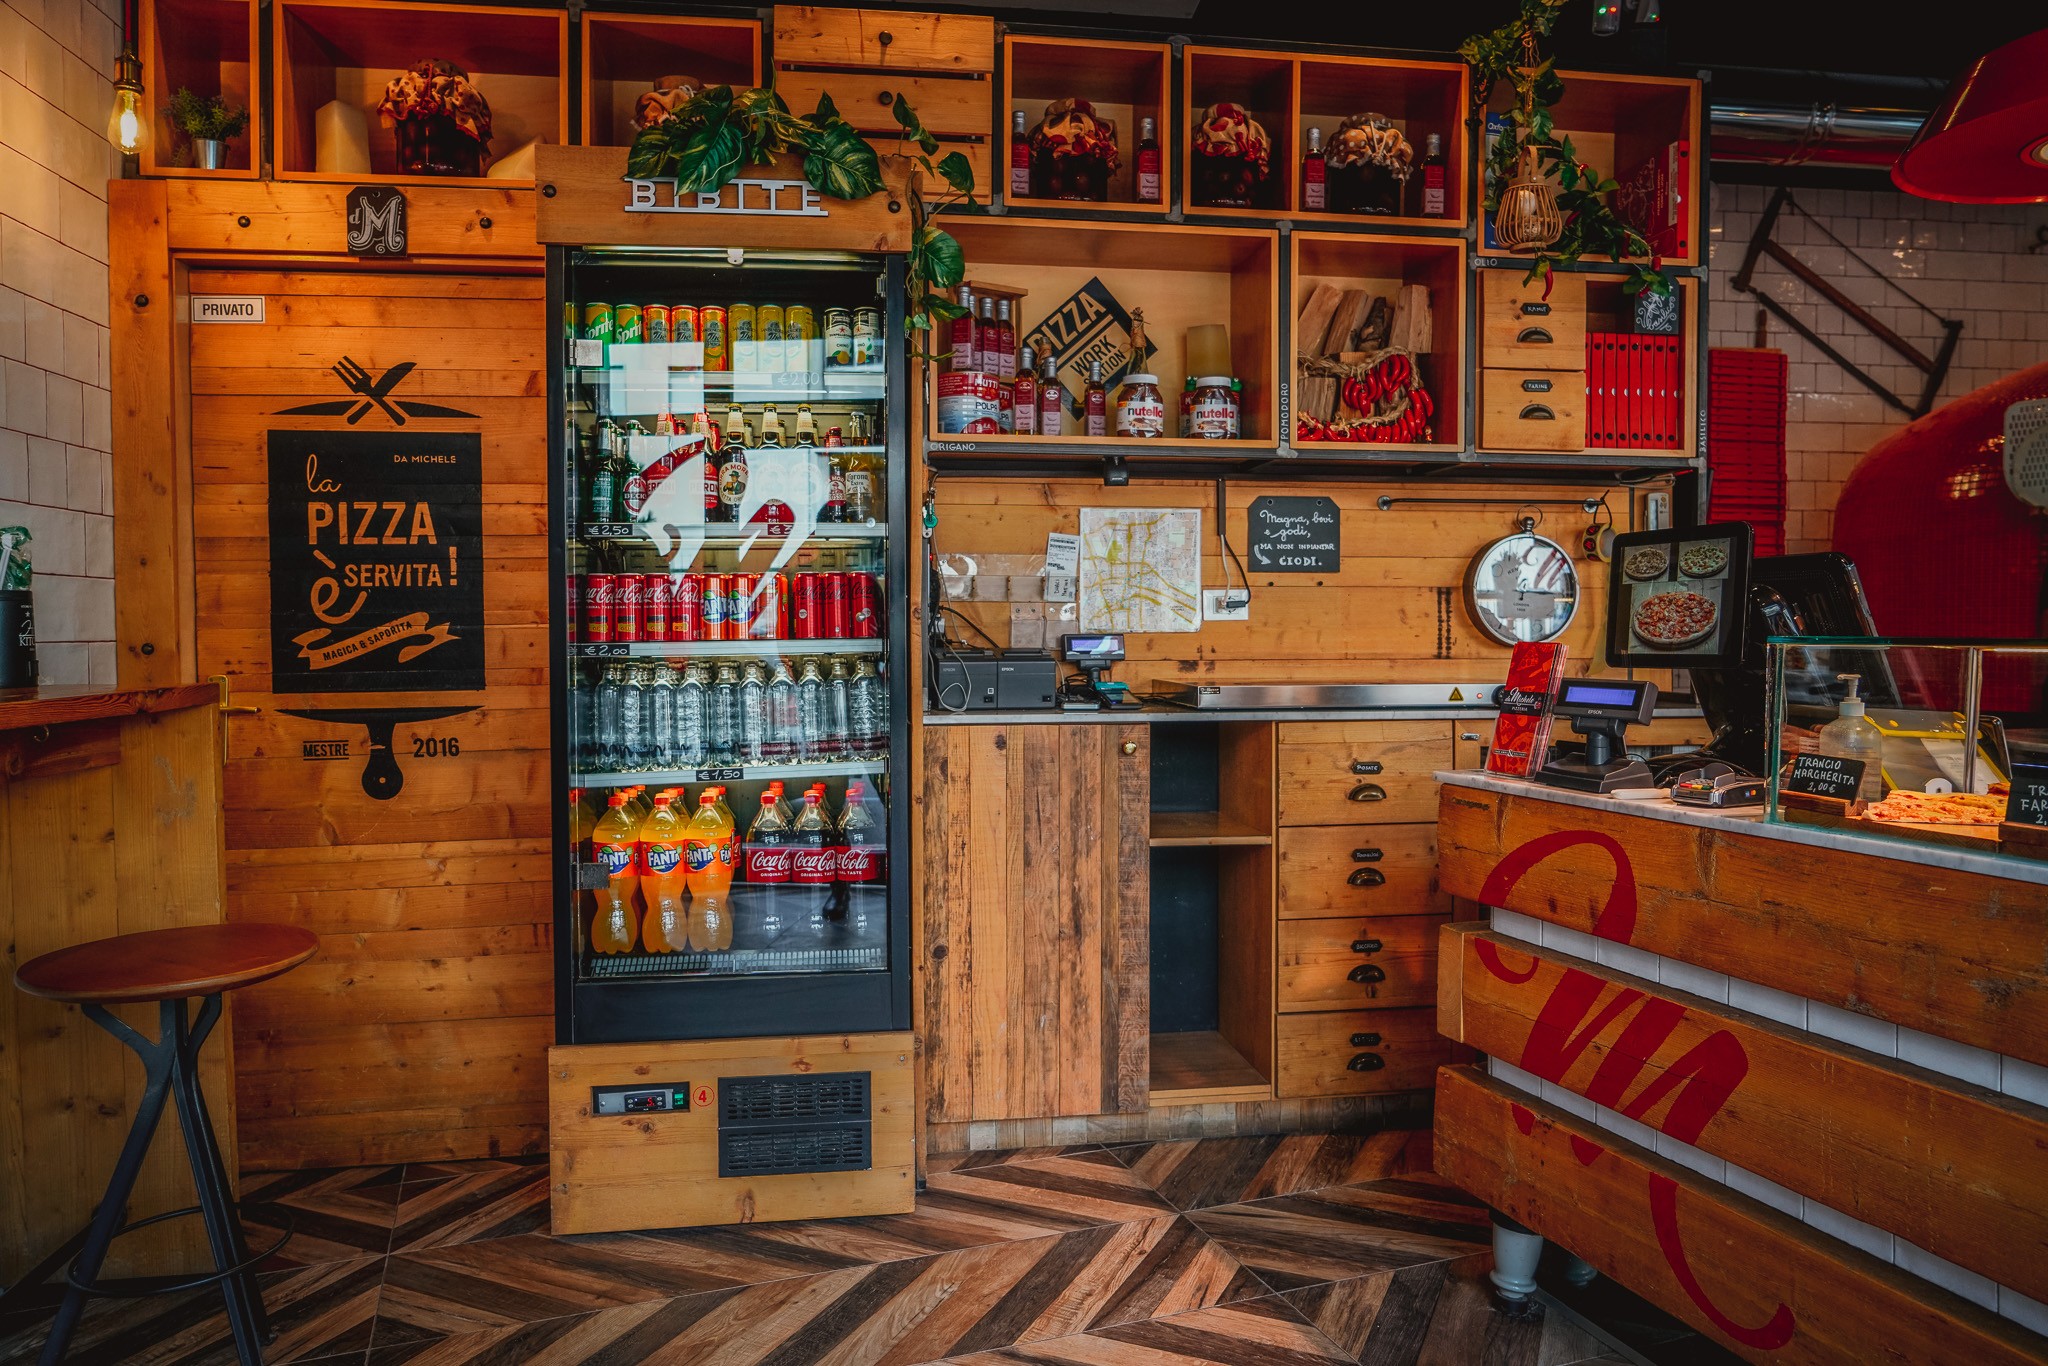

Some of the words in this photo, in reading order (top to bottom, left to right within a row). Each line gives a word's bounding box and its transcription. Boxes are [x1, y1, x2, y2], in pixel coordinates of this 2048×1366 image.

[1488, 123, 1505, 131] Oxfo
[1473, 257, 1498, 267] OLIO
[202, 303, 254, 316] PRIVATO
[1026, 291, 1107, 352] PIZZA
[1070, 335, 1117, 377] WORK
[1083, 350, 1127, 386] SATION
[975, 401, 998, 412] POLPA
[1128, 405, 1163, 418] nutella
[1195, 407, 1235, 419] nutella
[1280, 382, 1289, 440] POMODORO
[1697, 409, 1707, 453] BASILICO
[929, 441, 976, 452] ORIGANO
[393, 454, 408, 463] DA
[411, 455, 457, 463] MICHELE
[306, 453, 342, 493] la
[308, 501, 438, 545] PIZZA
[1259, 509, 1310, 528] Magna,
[1269, 523, 1311, 542] godi,
[322, 643, 360, 662] MAGICA
[359, 639, 368, 649] &
[367, 620, 413, 646] SAPORITA
[302, 743, 350, 758] MESTRE
[412, 737, 460, 758] 2016
[1798, 757, 1842, 770] TRANCIO
[1793, 768, 1855, 786] MARGHERITA
[595, 850, 631, 866] FANTA
[647, 850, 681, 867] FANTA
[685, 849, 715, 863] FANTA
[698, 1089, 708, 1103] 4
